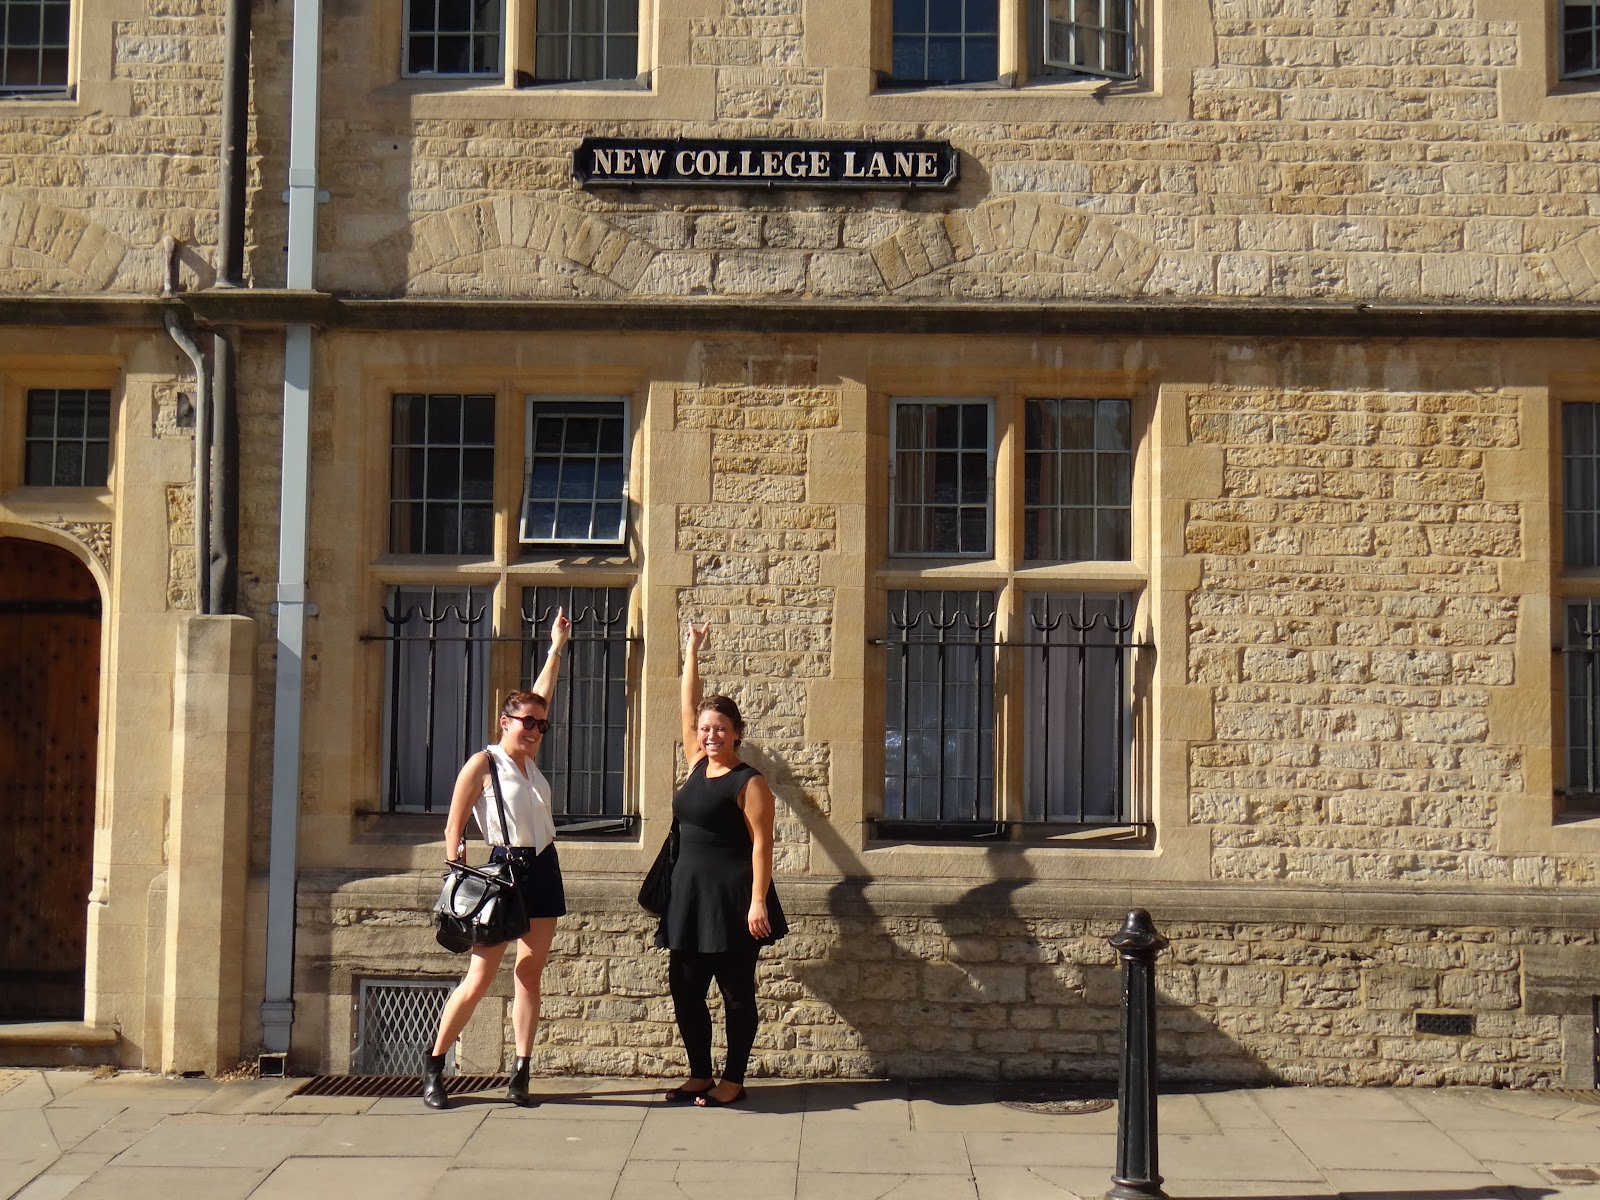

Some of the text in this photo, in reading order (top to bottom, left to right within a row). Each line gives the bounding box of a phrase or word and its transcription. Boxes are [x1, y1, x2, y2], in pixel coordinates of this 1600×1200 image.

[590, 148, 939, 178] NEW COLLEGE LANE
